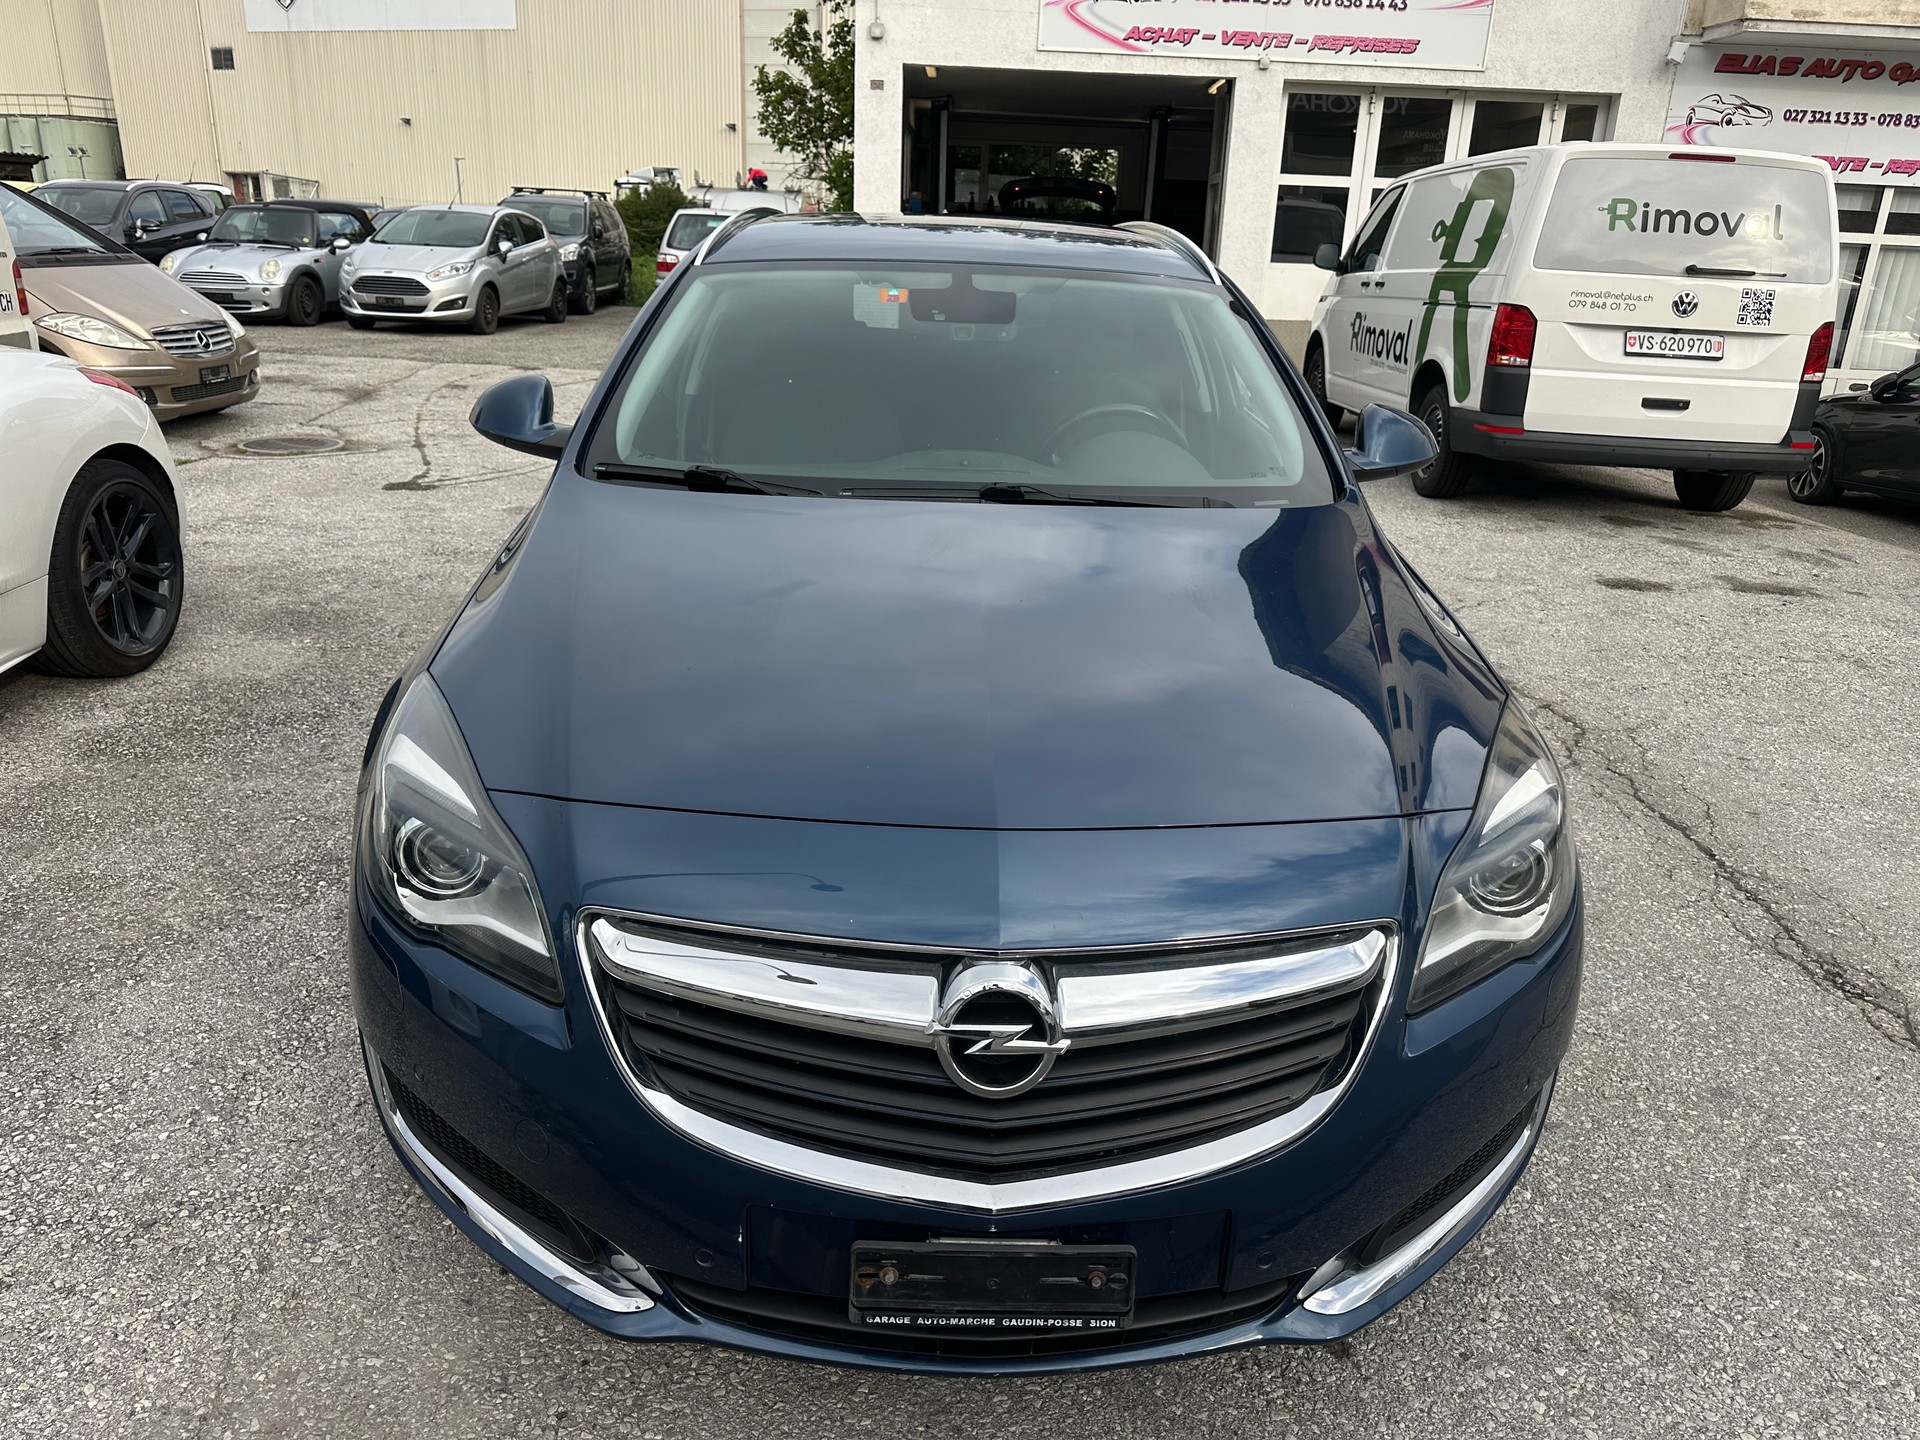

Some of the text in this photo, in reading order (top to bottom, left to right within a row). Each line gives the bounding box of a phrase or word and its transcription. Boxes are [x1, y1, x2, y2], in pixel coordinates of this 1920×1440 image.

[1123, 26, 1200, 46] ACHAT
[1221, 30, 1294, 50] VENTE
[1308, 34, 1421, 55] REPRISES
[1714, 53, 1805, 76] ELIAS
[1801, 58, 1886, 83] AUTO
[1783, 109, 1808, 123] 027
[1808, 110, 1832, 124] 321
[1834, 111, 1851, 125] 13
[1851, 112, 1868, 126] 33
[1877, 113, 1903, 127] 078
[1811, 155, 1870, 174] NTE
[1606, 198, 1784, 240] Rimoval
[0, 293, 13, 312] CH
[1570, 290, 1654, 302] rimoval@netplus.ch
[1568, 300, 1637, 312] 079 848 01 70
[1350, 311, 1413, 366] Rimoval
[866, 1316, 1116, 1328] GARAGE AUTO-MARCHE GAUDIN-POSSE SION
